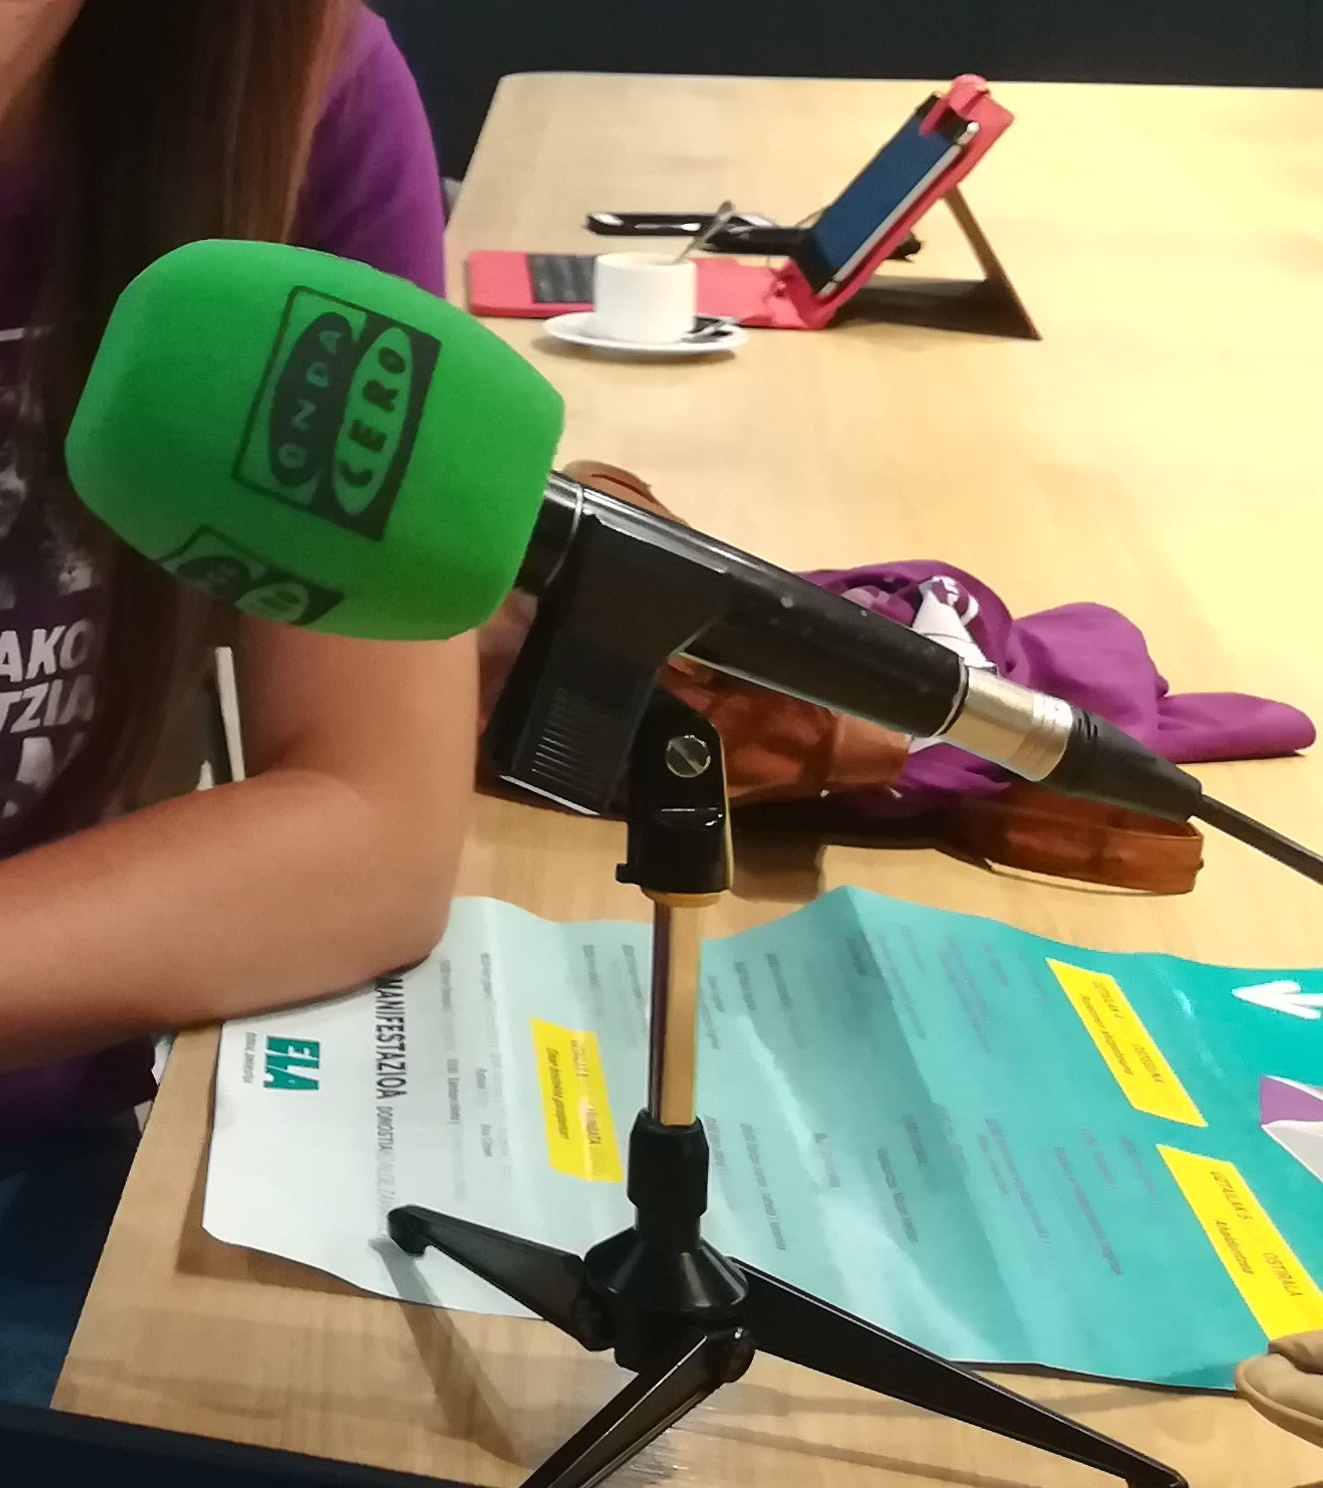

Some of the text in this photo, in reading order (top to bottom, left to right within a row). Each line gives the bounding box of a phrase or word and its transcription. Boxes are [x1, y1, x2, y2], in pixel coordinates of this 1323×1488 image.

[278, 330, 342, 470] ONDA
[339, 345, 407, 488] CERO
[263, 1035, 320, 1091] ELA
